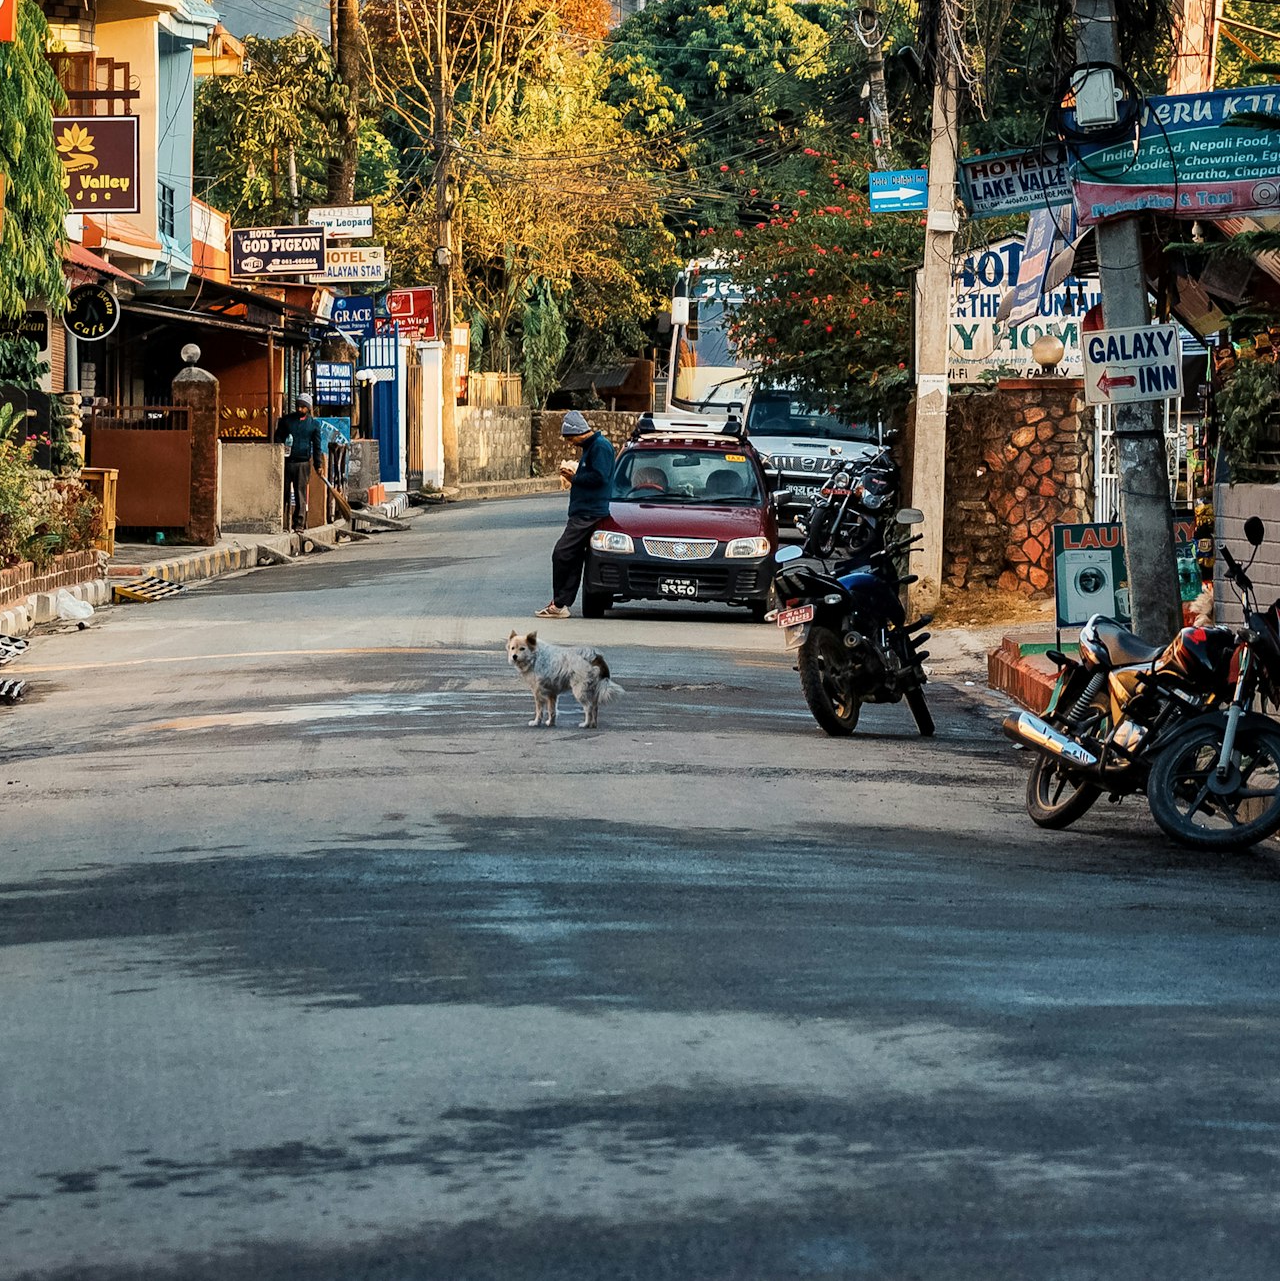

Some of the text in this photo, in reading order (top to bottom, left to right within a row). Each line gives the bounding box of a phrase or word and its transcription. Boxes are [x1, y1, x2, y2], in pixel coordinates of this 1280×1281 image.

[1102, 146, 1146, 164] Indian
[1148, 142, 1186, 158] Food,
[1189, 137, 1233, 154] Nepali
[1235, 133, 1272, 150] Food,
[1184, 150, 1258, 168] Chowmien,
[80, 174, 130, 202] Valley
[970, 177, 1016, 202] LAKE
[1181, 192, 1192, 207] &
[1196, 189, 1235, 207] Taxi
[336, 217, 373, 228] Leopard
[249, 230, 278, 239] HOTEL
[241, 237, 321, 254] GOD PIGEON
[360, 265, 382, 277] STAR
[97, 290, 114, 316] Bean
[334, 308, 372, 323] GRACE
[948, 322, 1079, 351] Y HOM
[1088, 329, 1175, 365] GALAXY
[1138, 364, 1178, 394] INN
